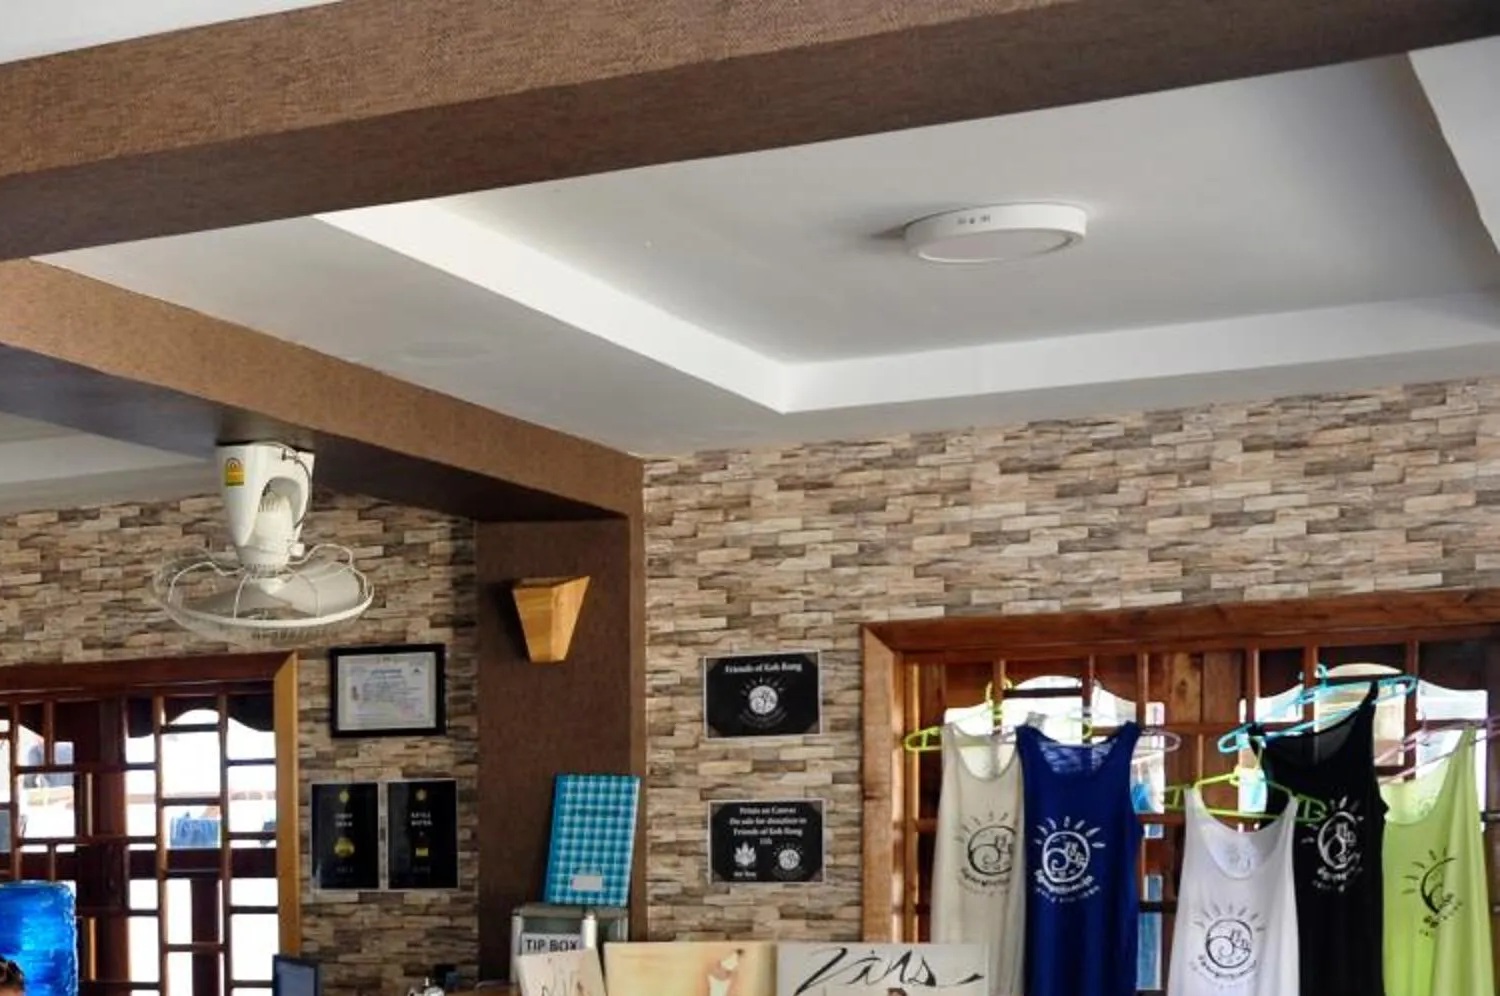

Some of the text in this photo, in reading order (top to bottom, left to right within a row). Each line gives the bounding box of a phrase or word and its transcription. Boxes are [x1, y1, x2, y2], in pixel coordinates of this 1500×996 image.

[724, 664, 754, 673] Friends
[764, 662, 780, 672] Koh
[742, 817, 754, 825] sale
[755, 816, 765, 825] for
[733, 827, 758, 836] Friends
[769, 827, 783, 835] Koh
[784, 827, 803, 837] Rong
[526, 939, 579, 953] TIP BOX
